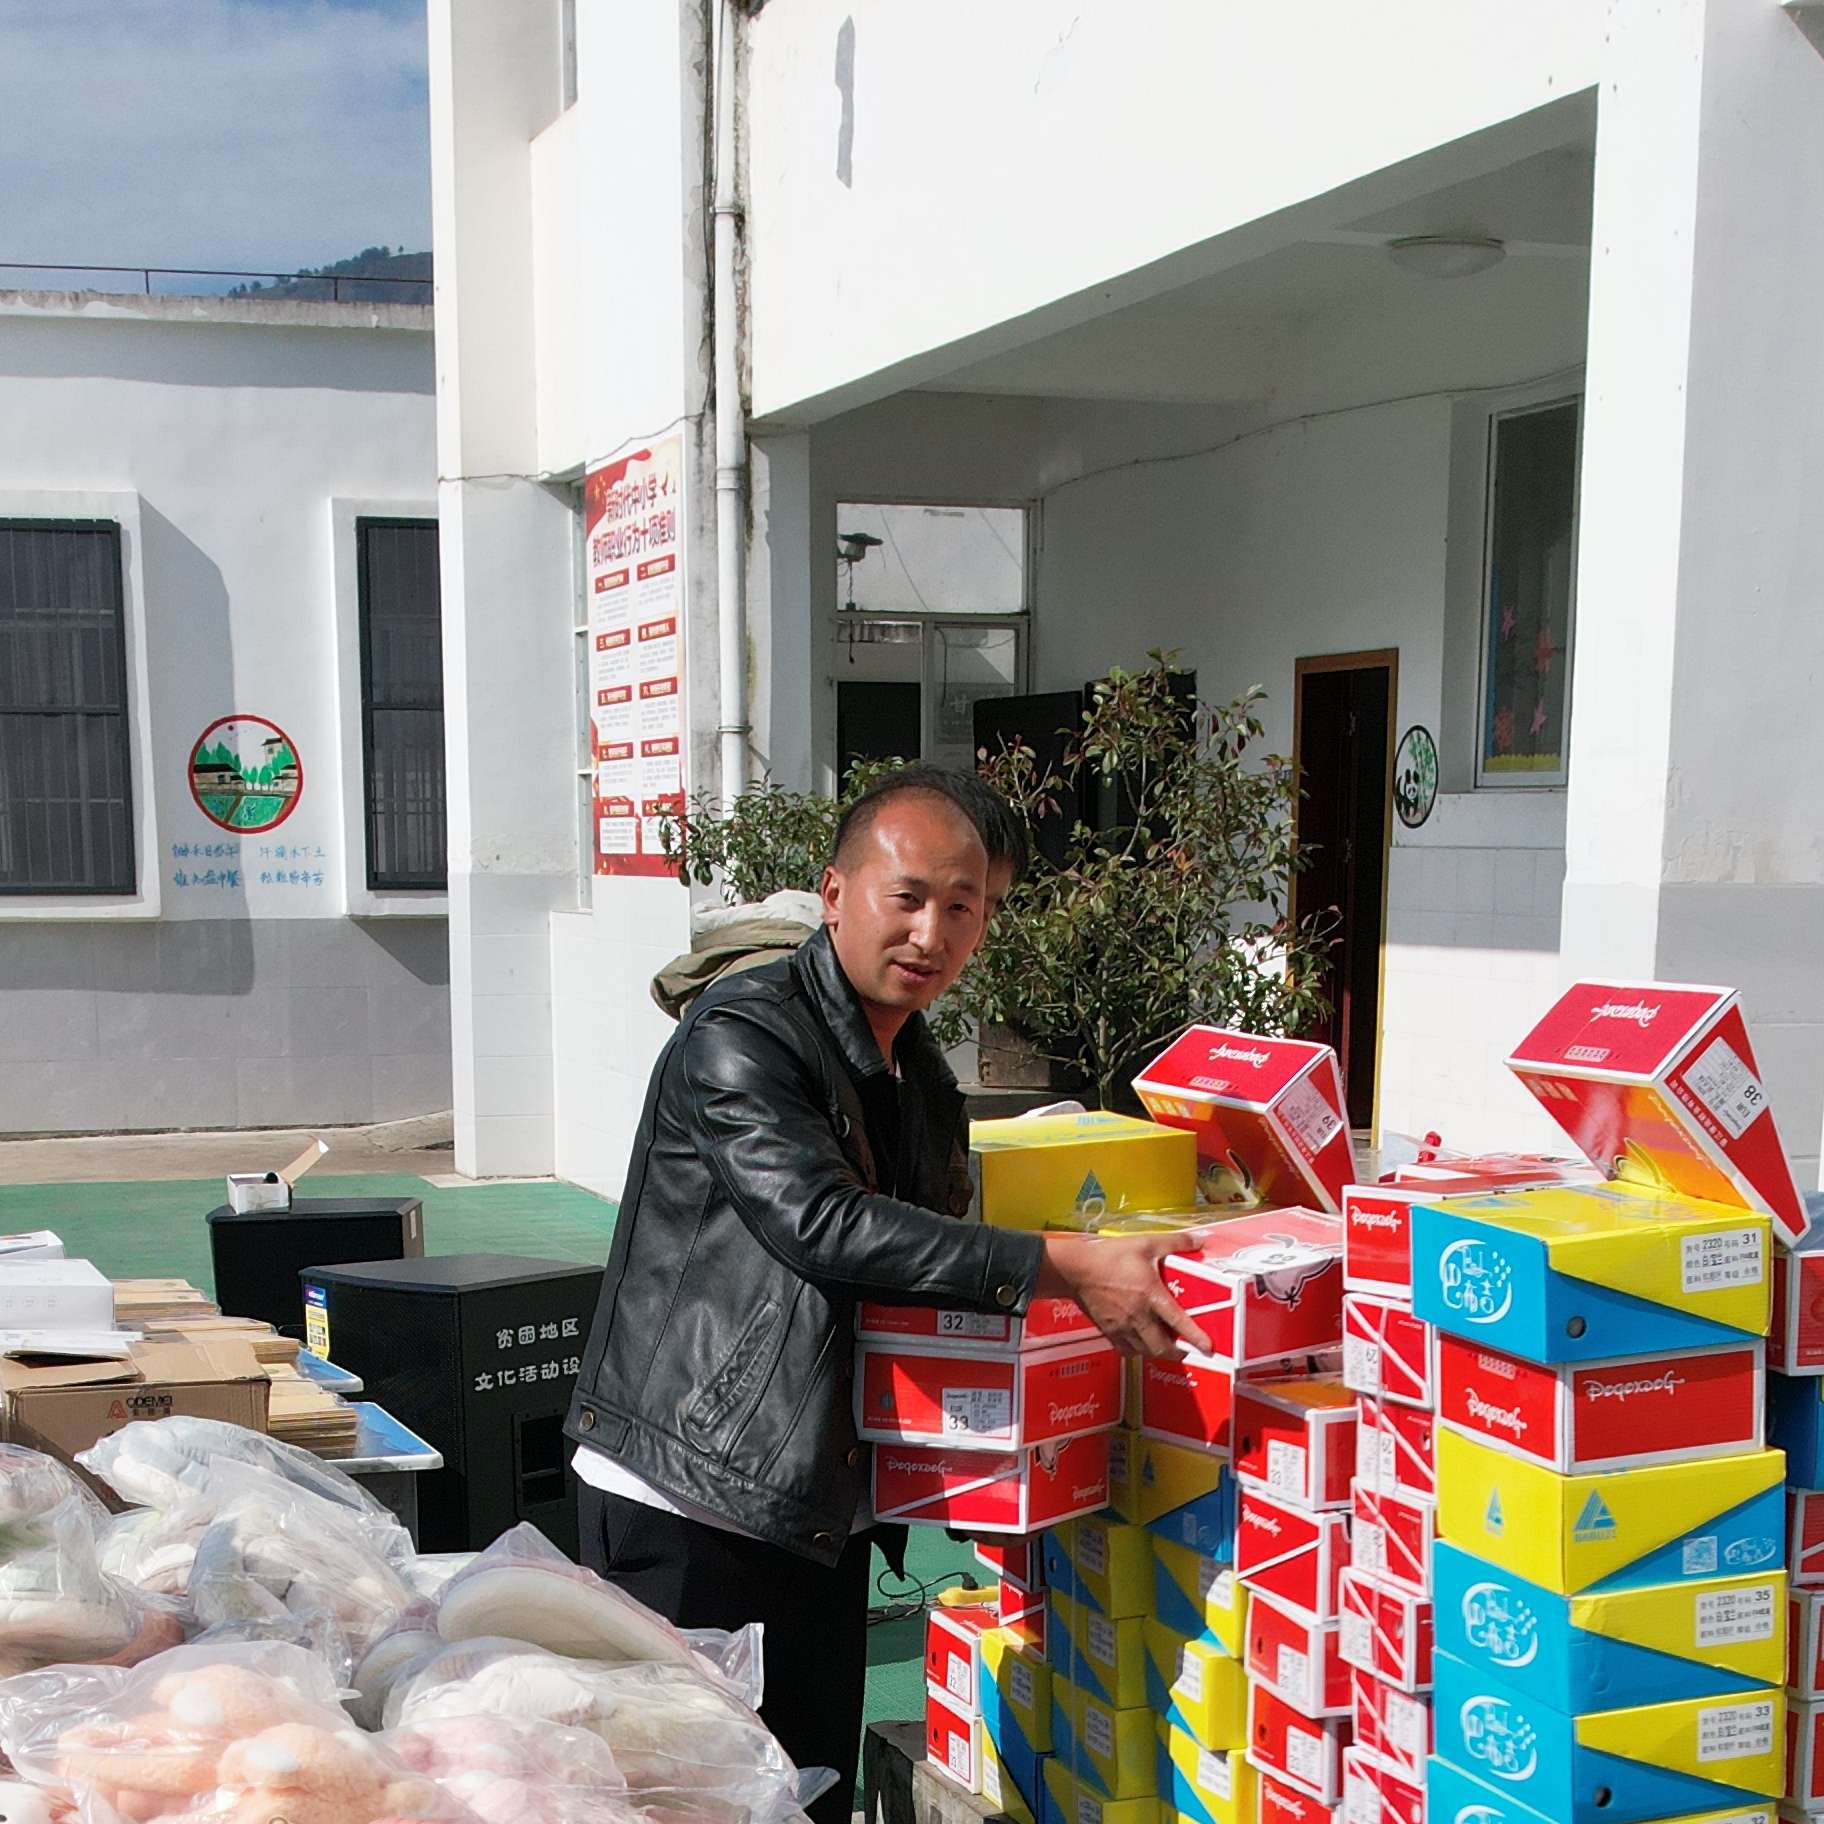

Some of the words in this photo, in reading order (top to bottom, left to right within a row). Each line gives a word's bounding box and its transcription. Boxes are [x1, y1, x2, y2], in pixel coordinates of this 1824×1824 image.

[1742, 1233, 1757, 1244] 31
[943, 1314, 963, 1330] 32
[1755, 1590, 1770, 1601] 35
[1755, 1706, 1770, 1717] 33
